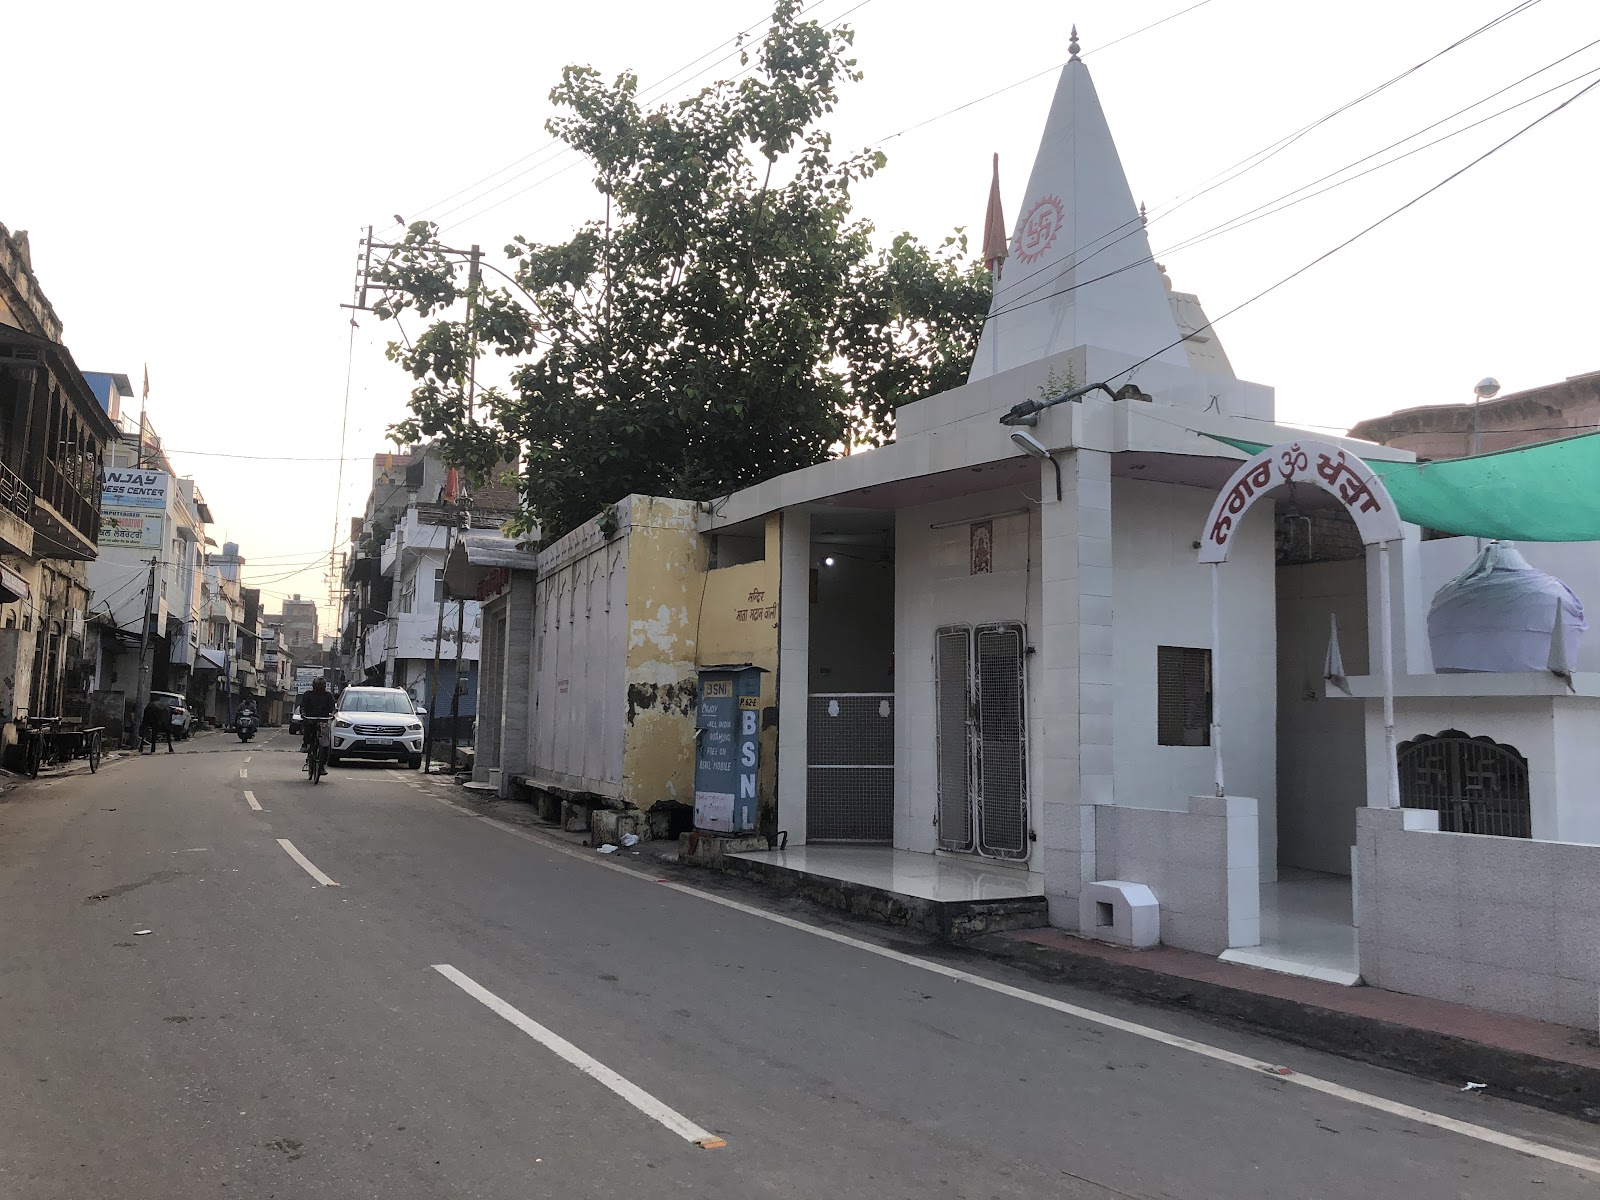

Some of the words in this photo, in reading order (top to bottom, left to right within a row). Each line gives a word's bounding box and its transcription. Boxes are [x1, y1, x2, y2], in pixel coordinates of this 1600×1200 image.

[127, 487, 164, 496] CENTER
[1209, 457, 1274, 545] ਨਗਰ
[701, 703, 718, 714] ENJOY
[707, 720, 717, 728] ALL
[718, 721, 731, 729] INDIA
[706, 746, 718, 756] FREE
[712, 760, 731, 771] MOBILE
[741, 711, 756, 829] BSNL
